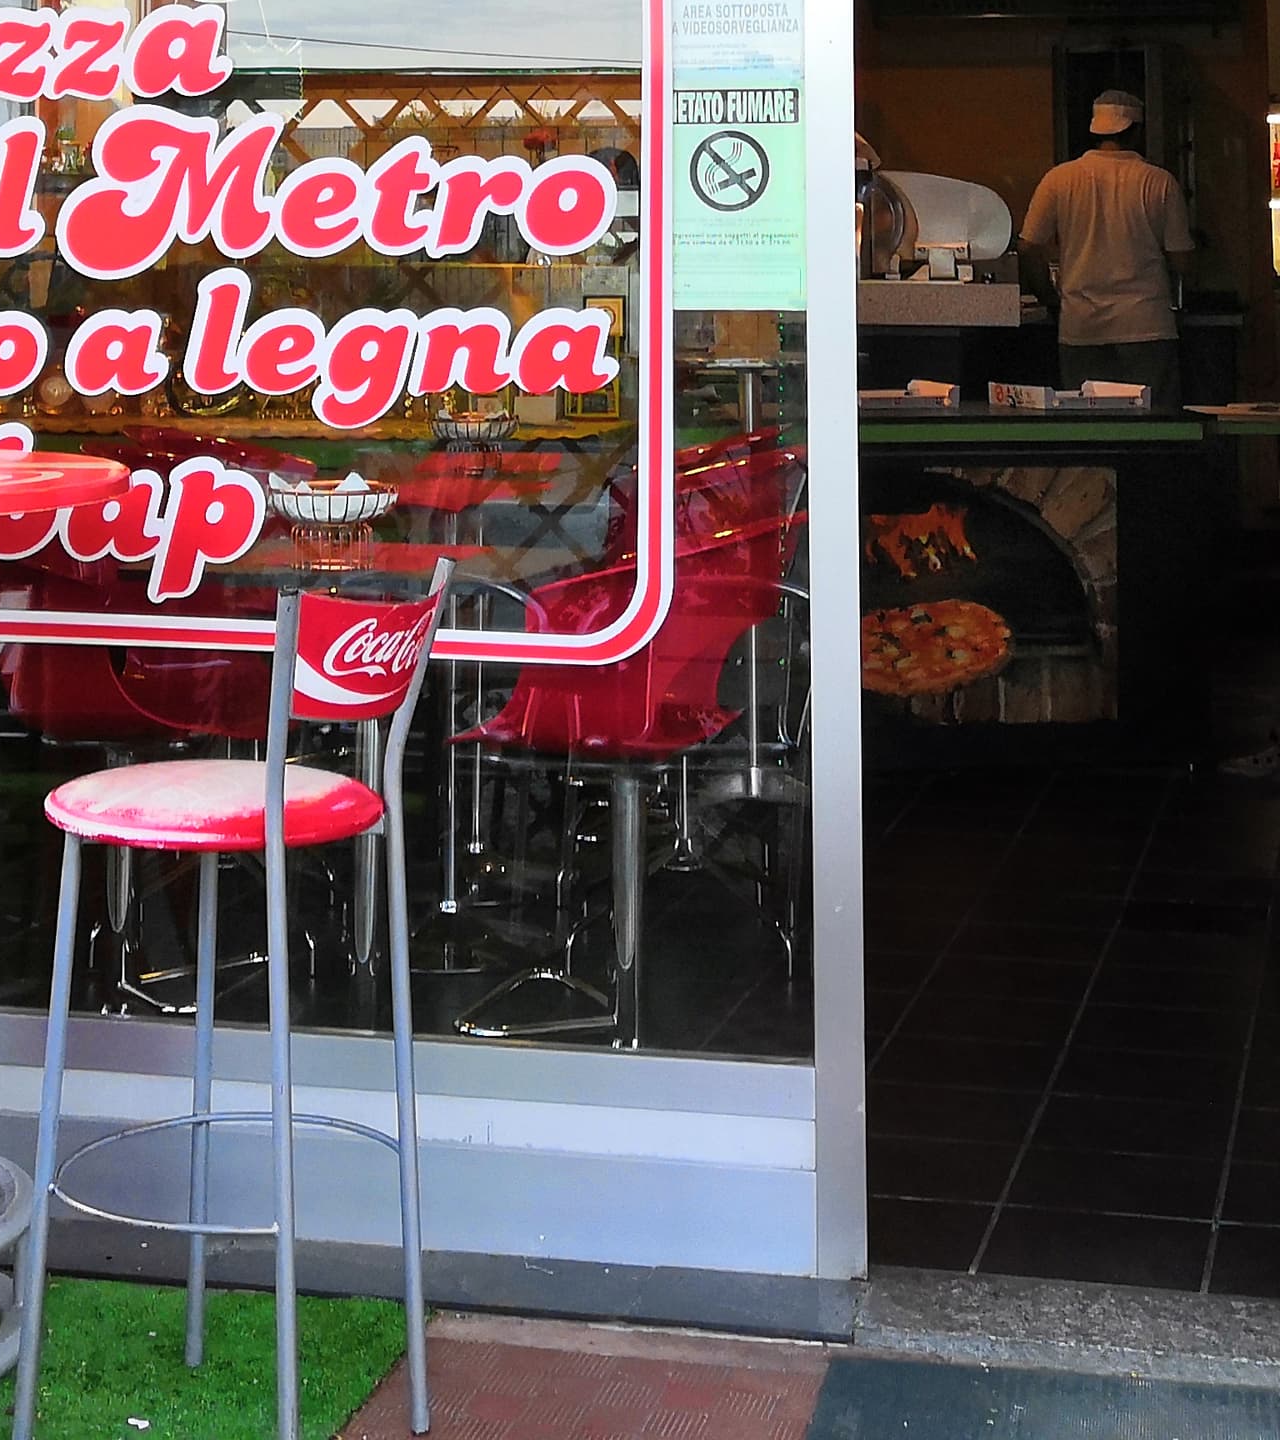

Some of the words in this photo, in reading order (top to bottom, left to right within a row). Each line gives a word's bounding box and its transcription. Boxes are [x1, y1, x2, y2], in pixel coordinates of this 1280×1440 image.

[682, 18, 799, 35] VIDEOSORVEGLIANZA
[683, 4, 712, 19] AREA
[716, 2, 788, 18] SOTTOPOSTA
[673, 90, 724, 123] IETATO
[727, 89, 795, 122] FUMARE
[59, 106, 614, 277] Metro
[67, 311, 166, 395] a
[185, 270, 617, 428] legna
